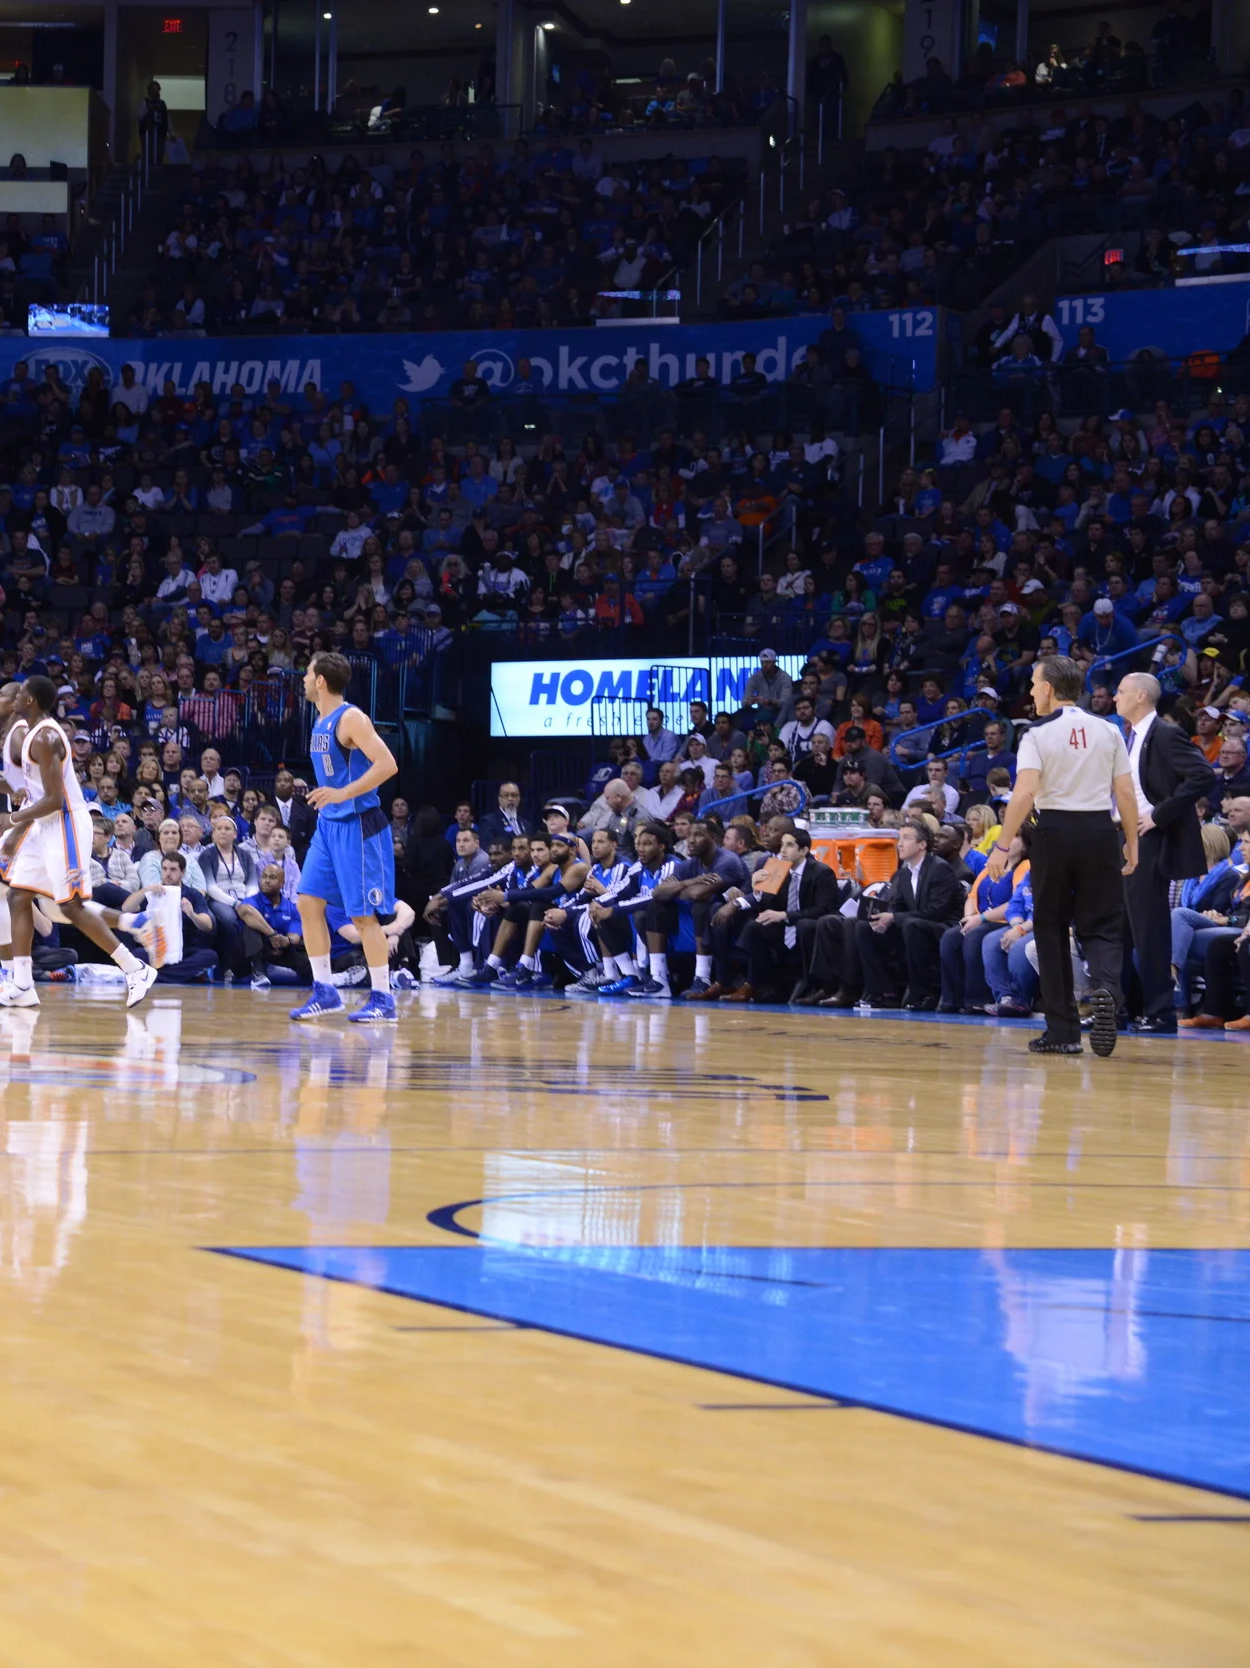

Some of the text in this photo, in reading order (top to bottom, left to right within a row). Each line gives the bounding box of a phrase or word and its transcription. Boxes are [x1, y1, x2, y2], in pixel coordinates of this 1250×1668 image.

[164, 20, 181, 32] EXIT
[920, 0, 935, 58] 19
[1057, 297, 1106, 325] 113
[888, 312, 934, 339] 112
[529, 667, 761, 706] HOMELAN
[1069, 727, 1087, 749] 41
